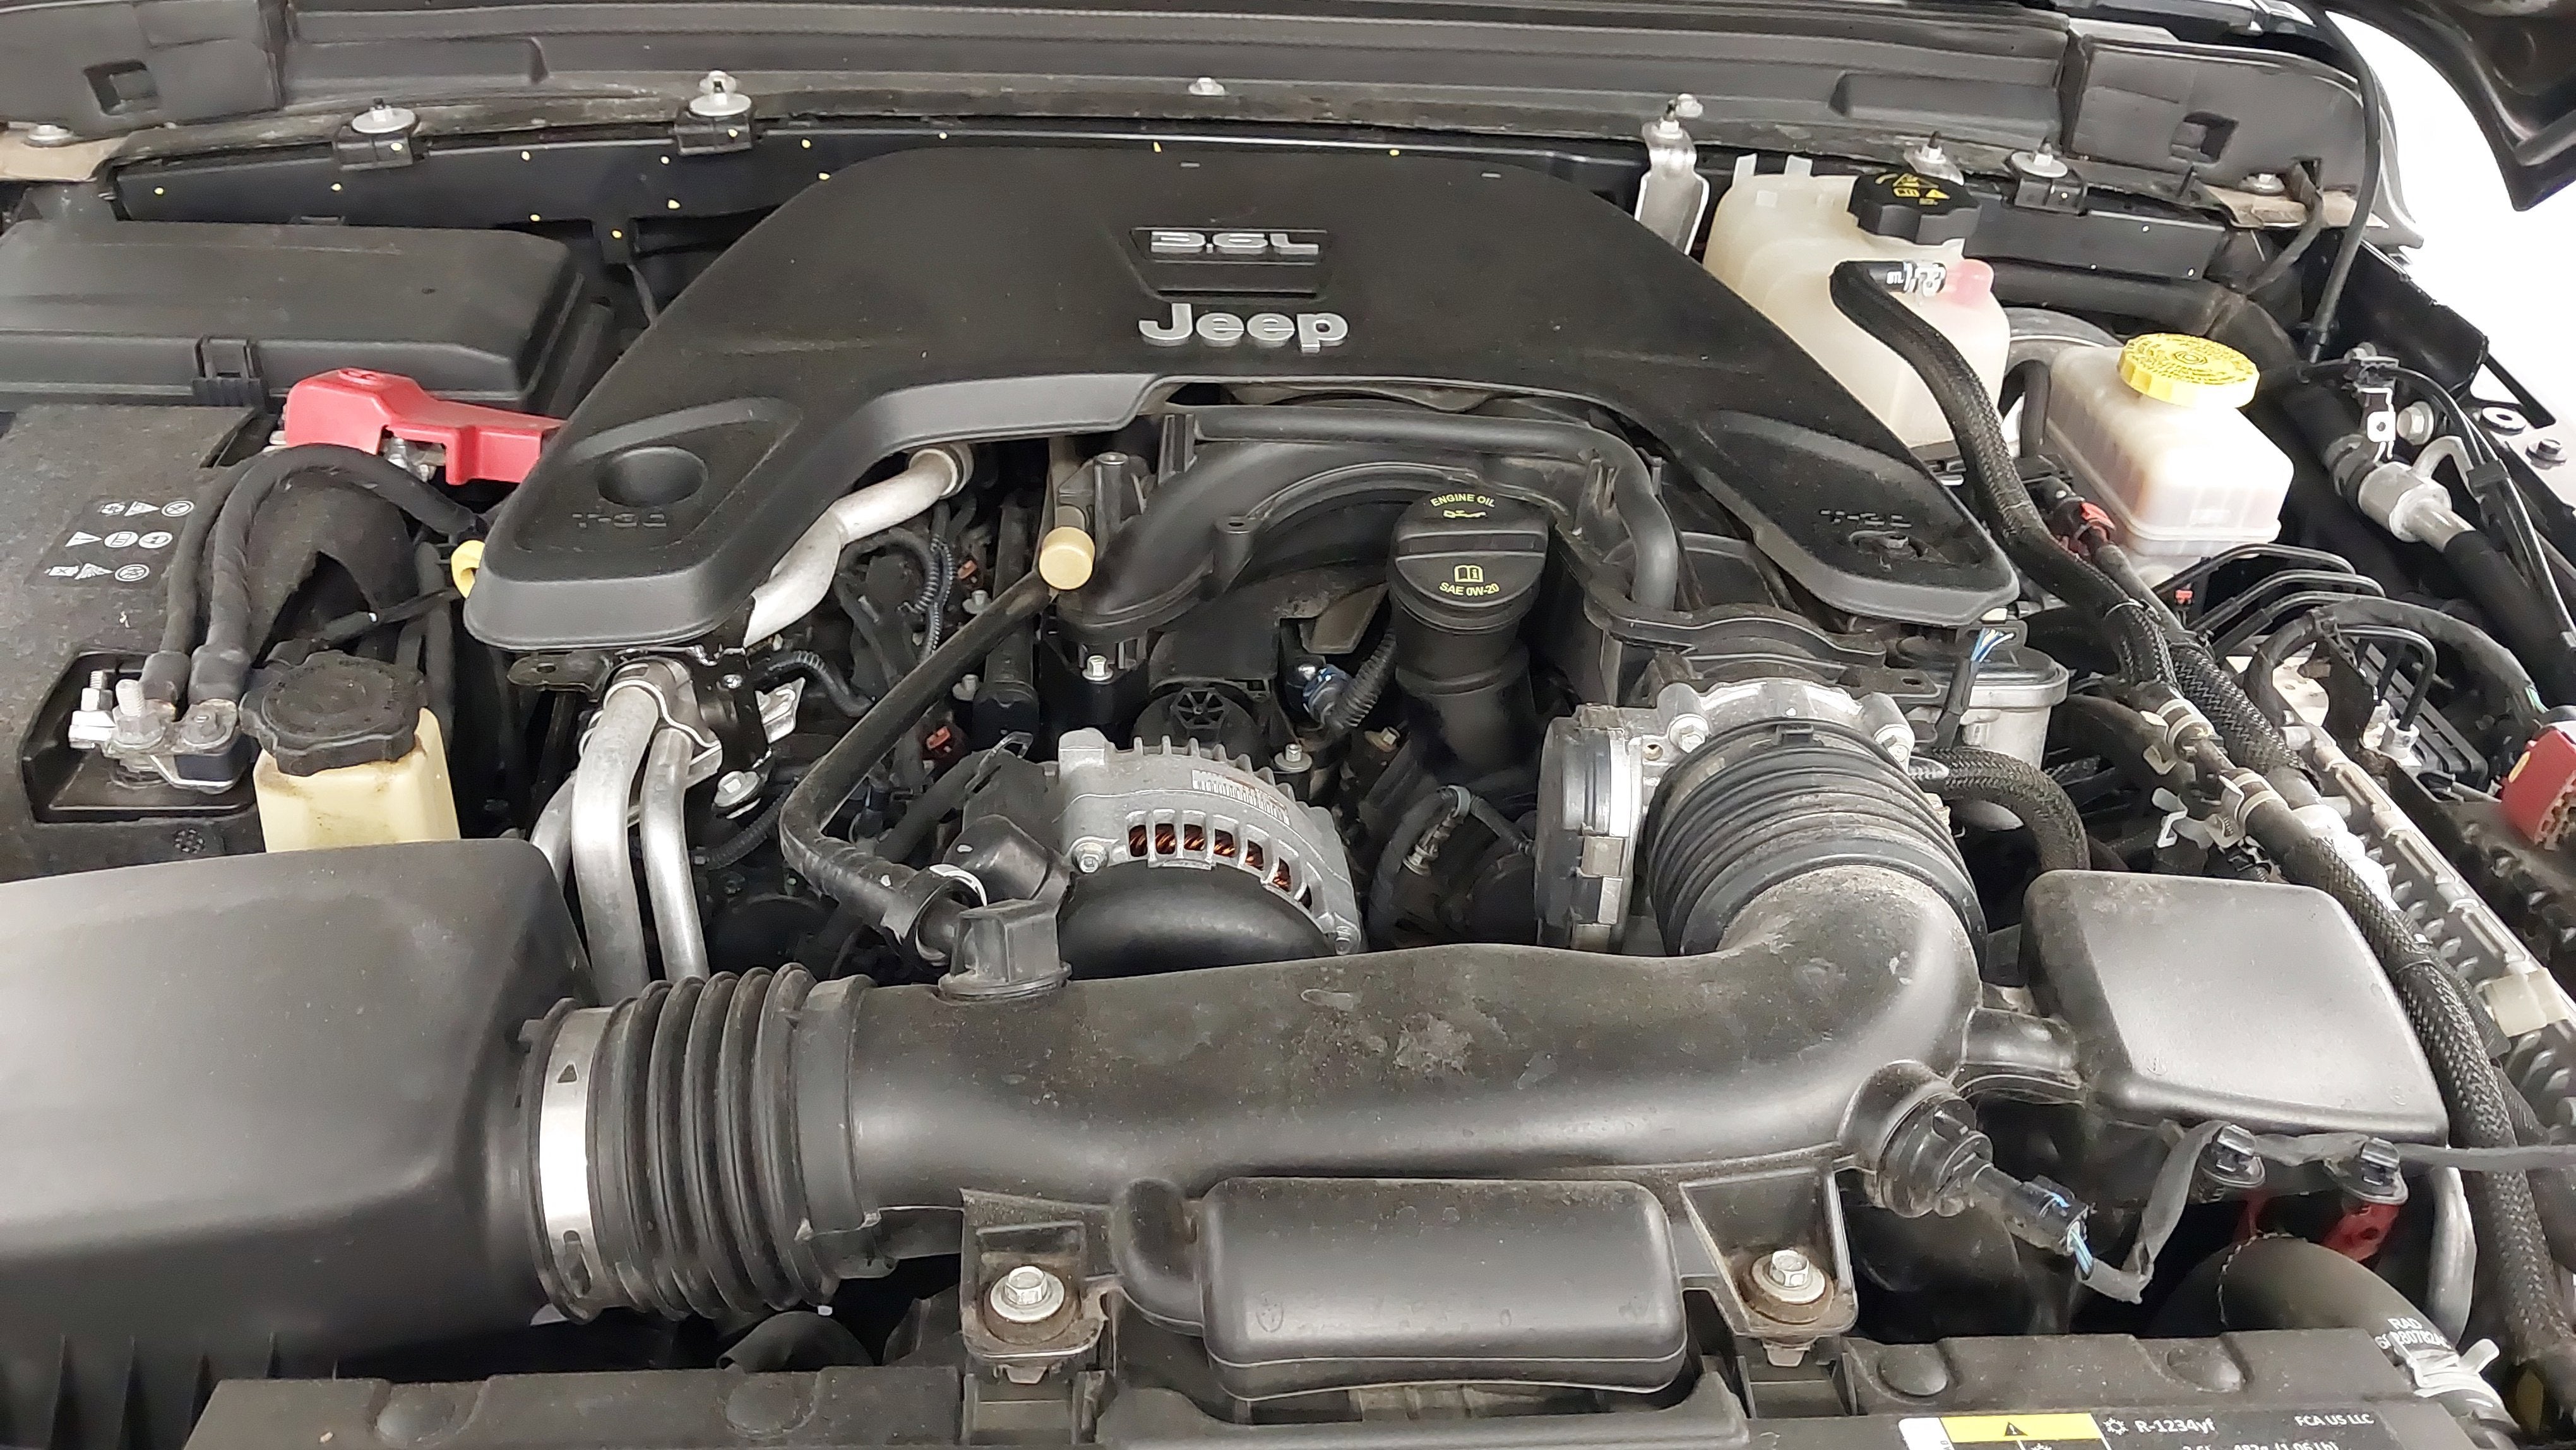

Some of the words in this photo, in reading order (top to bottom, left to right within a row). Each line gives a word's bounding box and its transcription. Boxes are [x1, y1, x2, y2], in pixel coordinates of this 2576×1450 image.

[1150, 231, 1320, 255] 3.6L
[1138, 303, 1349, 354] Jeep
[1429, 493, 1476, 507] ENGINE
[1476, 495, 1496, 508] OIL
[1439, 582, 1464, 596] SAE
[1466, 582, 1500, 596] 0W-20
[2387, 1317, 2423, 1329] RAD
[2134, 1417, 2215, 1434] R-1234yf
[2294, 1415, 2326, 1427] FCA
[2324, 1415, 2347, 1425] US
[2347, 1413, 2375, 1425] LLC
